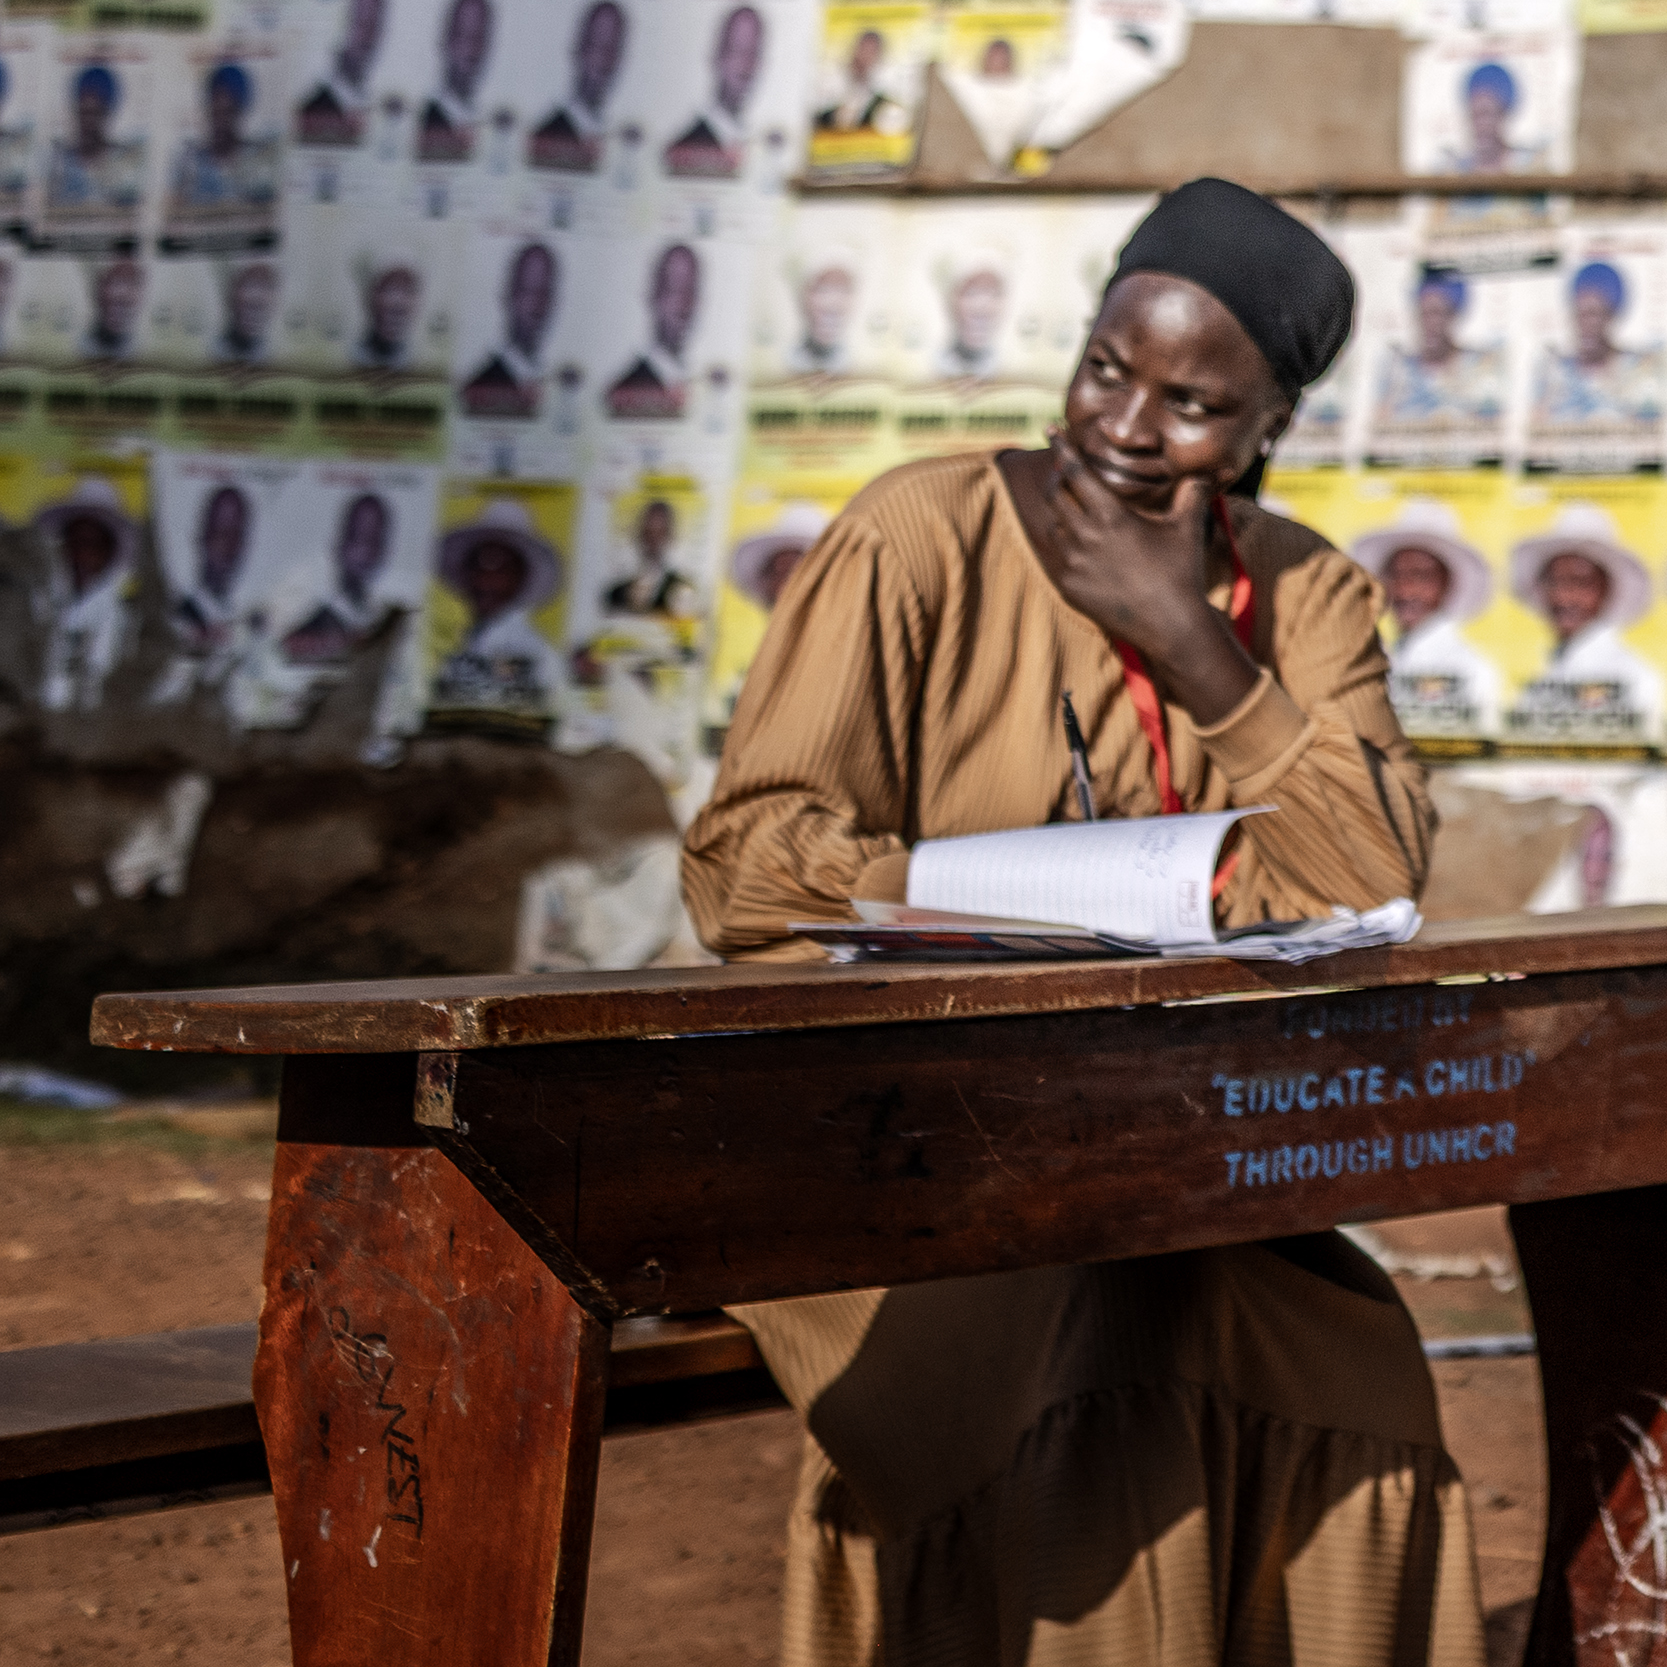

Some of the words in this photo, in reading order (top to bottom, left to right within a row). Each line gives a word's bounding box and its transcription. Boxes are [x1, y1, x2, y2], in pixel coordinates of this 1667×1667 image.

[1432, 993, 1475, 1027] BY
[1223, 1136, 1394, 1188] THROUGH
[1402, 1120, 1518, 1171] UNHCR
